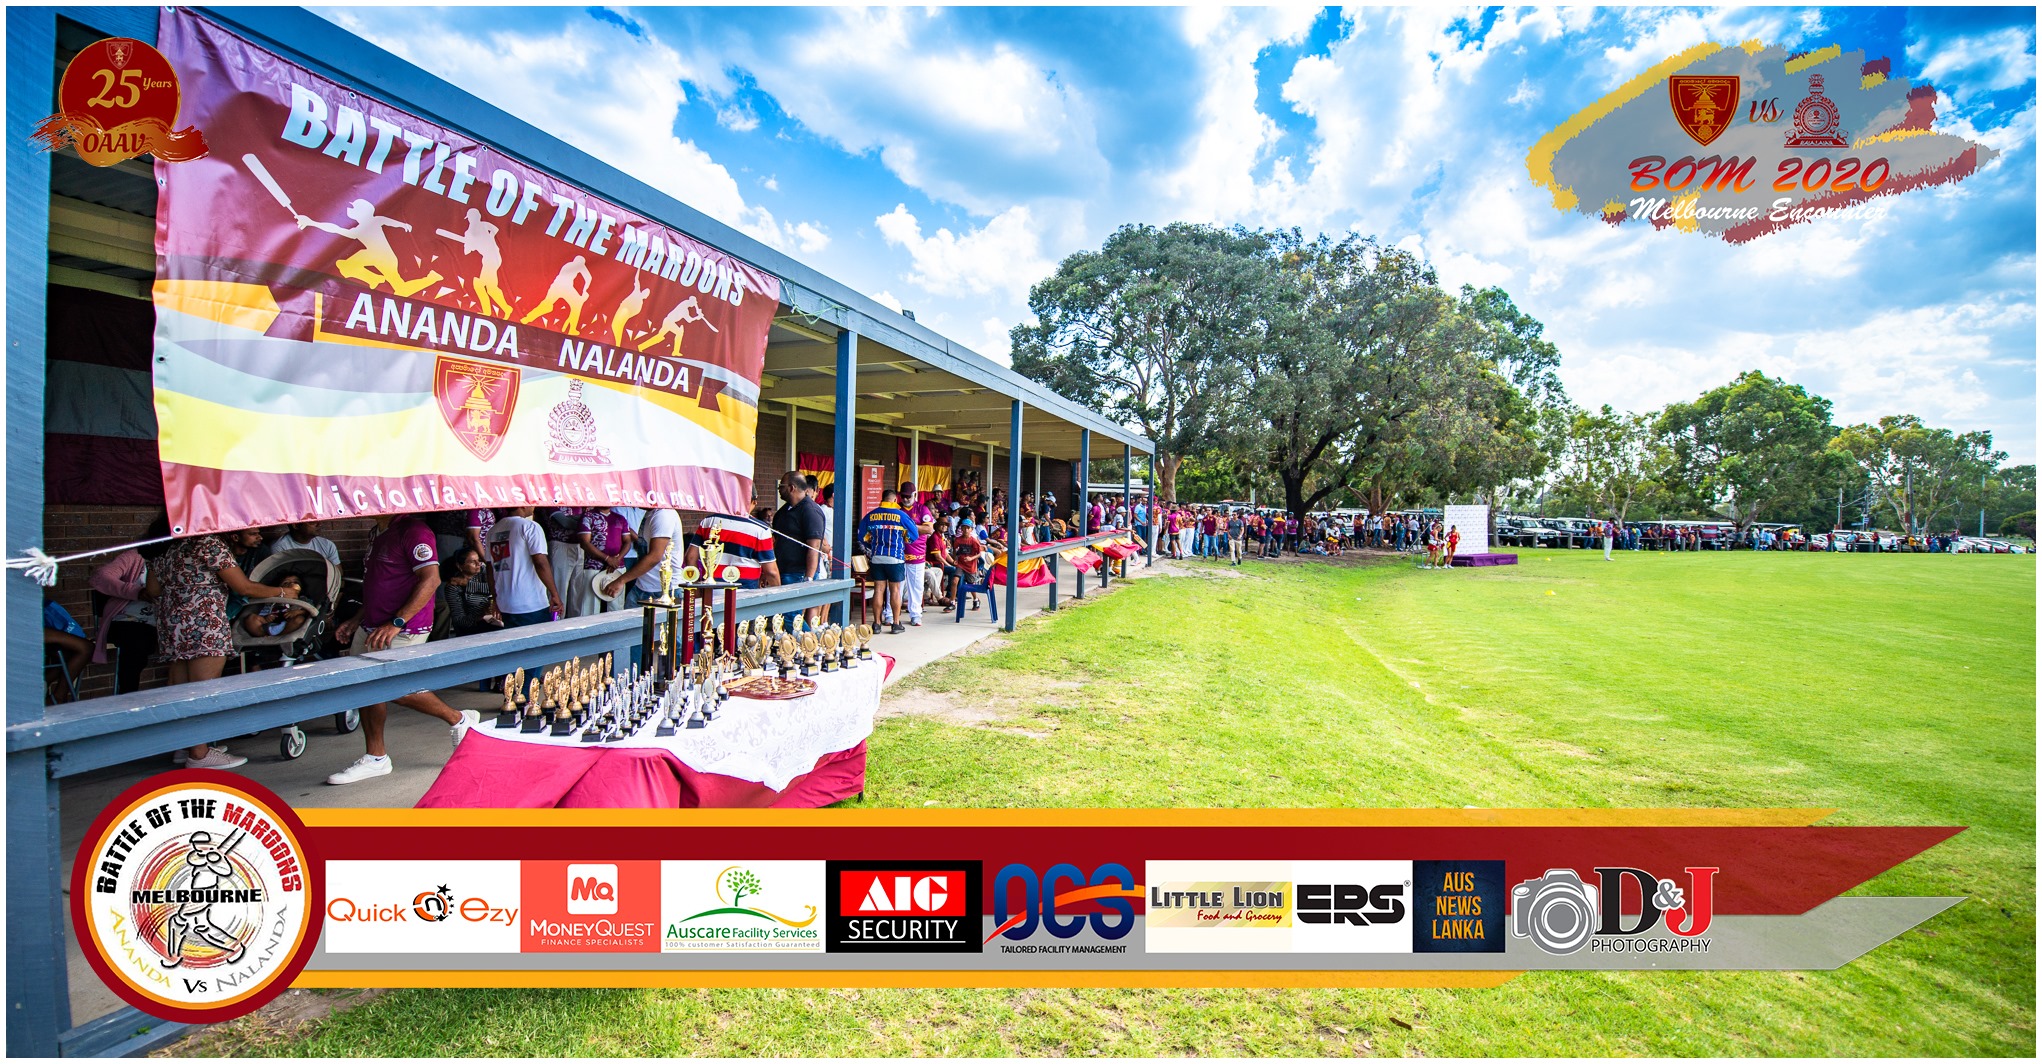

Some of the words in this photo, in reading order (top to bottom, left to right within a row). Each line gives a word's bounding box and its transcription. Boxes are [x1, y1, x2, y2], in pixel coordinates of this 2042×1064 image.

[281, 82, 477, 205] BATTLE
[485, 168, 543, 226] OF
[545, 193, 616, 252] THE
[615, 223, 747, 307] MAROONS
[345, 292, 519, 359] ANANDA
[558, 338, 690, 394] NALANDA
[605, 483, 705, 511] Encounter
